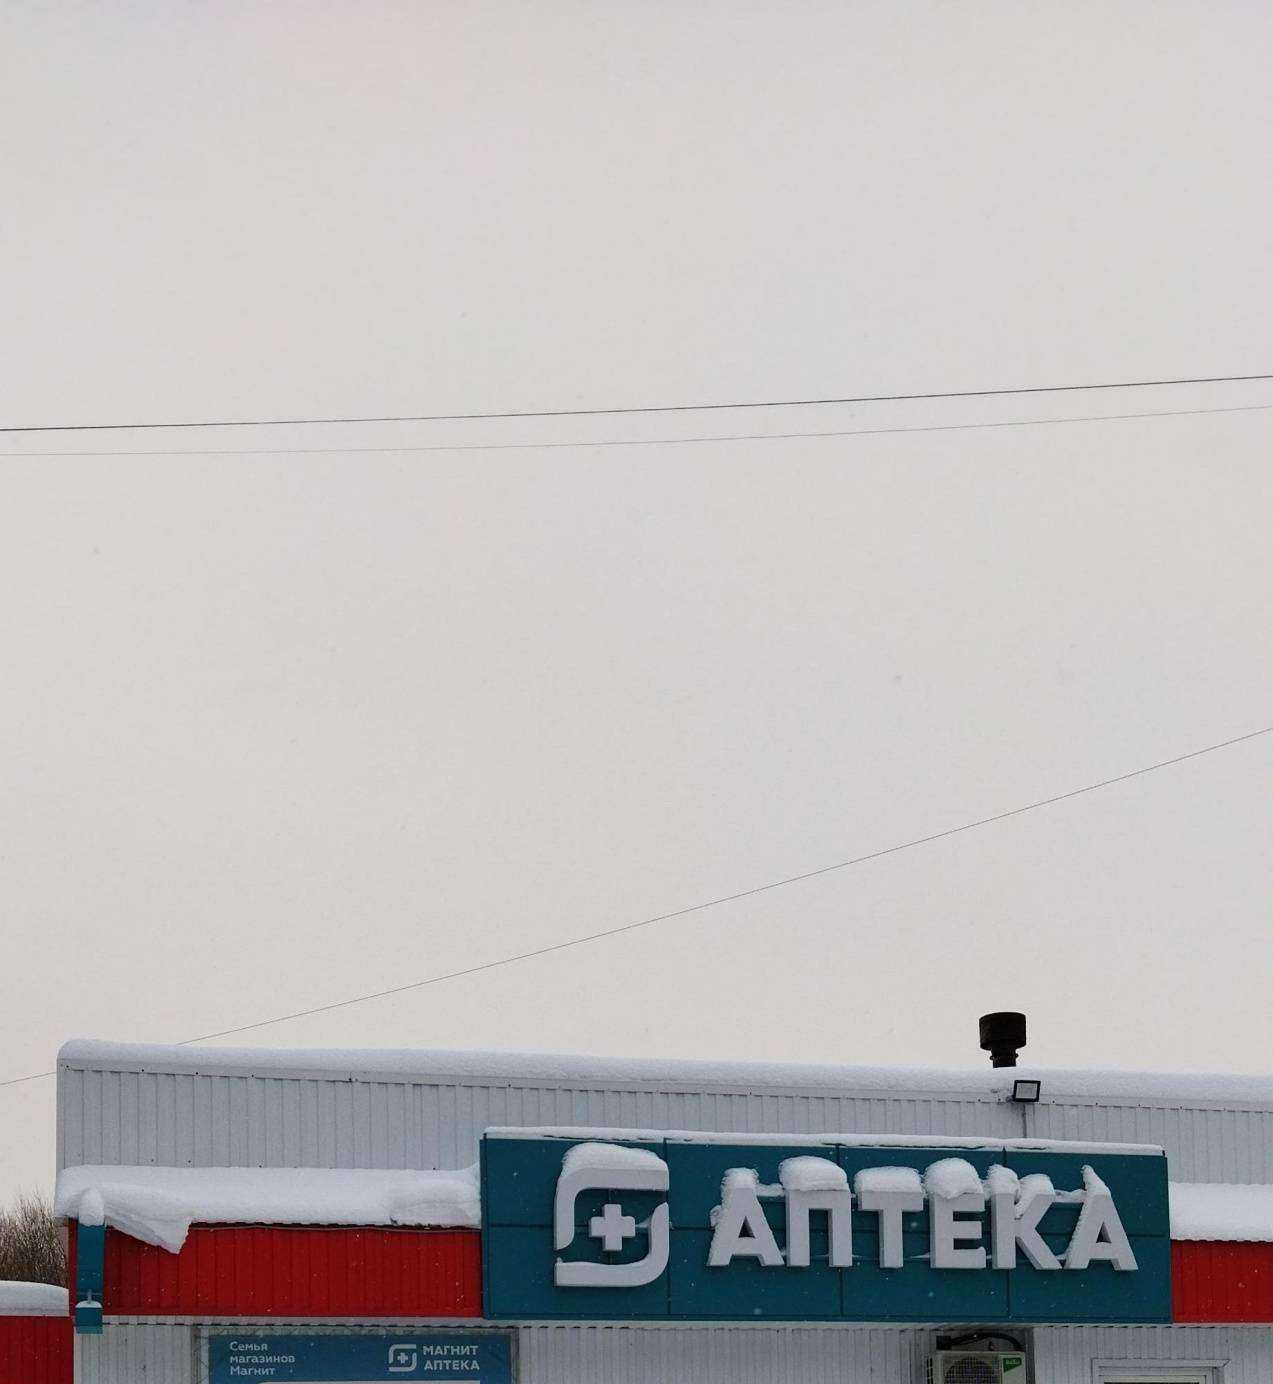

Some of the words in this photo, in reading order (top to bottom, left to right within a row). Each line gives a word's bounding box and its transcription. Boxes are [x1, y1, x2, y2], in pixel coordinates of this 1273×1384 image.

[707, 1186, 1139, 1271] АПТЕКА
[230, 1341, 268, 1351] Семья
[423, 1345, 479, 1355] МАГНИТ
[230, 1355, 296, 1363] магазинов
[424, 1360, 480, 1370] АПТЕКА
[230, 1366, 276, 1376] Магнит
